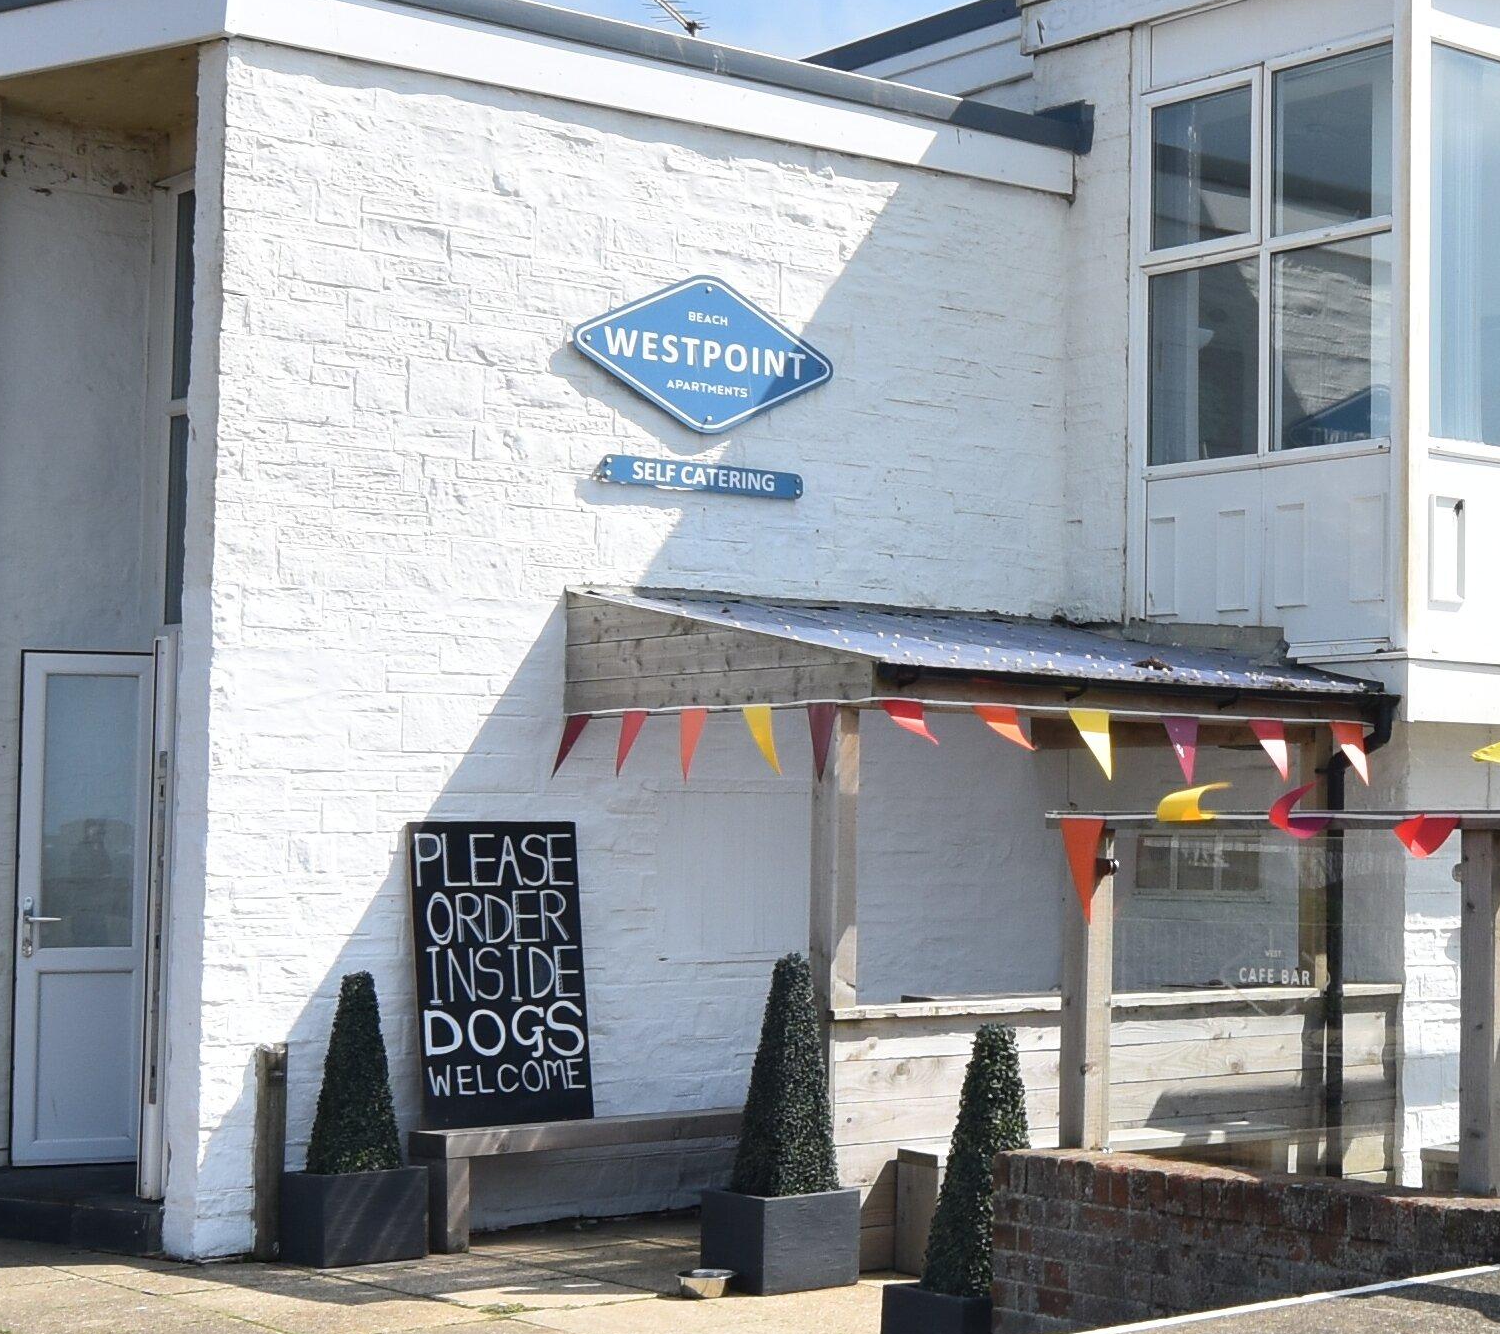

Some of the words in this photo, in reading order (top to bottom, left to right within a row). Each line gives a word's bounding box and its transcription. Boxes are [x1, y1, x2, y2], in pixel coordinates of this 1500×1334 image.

[688, 312, 728, 326] BEACH
[604, 326, 807, 380] WESTPOINT
[667, 381, 748, 398] APARTMENTS
[632, 461, 676, 482] SELF
[680, 466, 776, 492] CATERING
[414, 833, 574, 887] PLEASE
[426, 890, 571, 945] ORDER
[426, 944, 581, 1005] INSIDE
[1239, 968, 1274, 984] CAFE
[1281, 969, 1311, 986] BAR
[423, 1000, 586, 1058] DOGS
[428, 1058, 587, 1097] WELCOME
